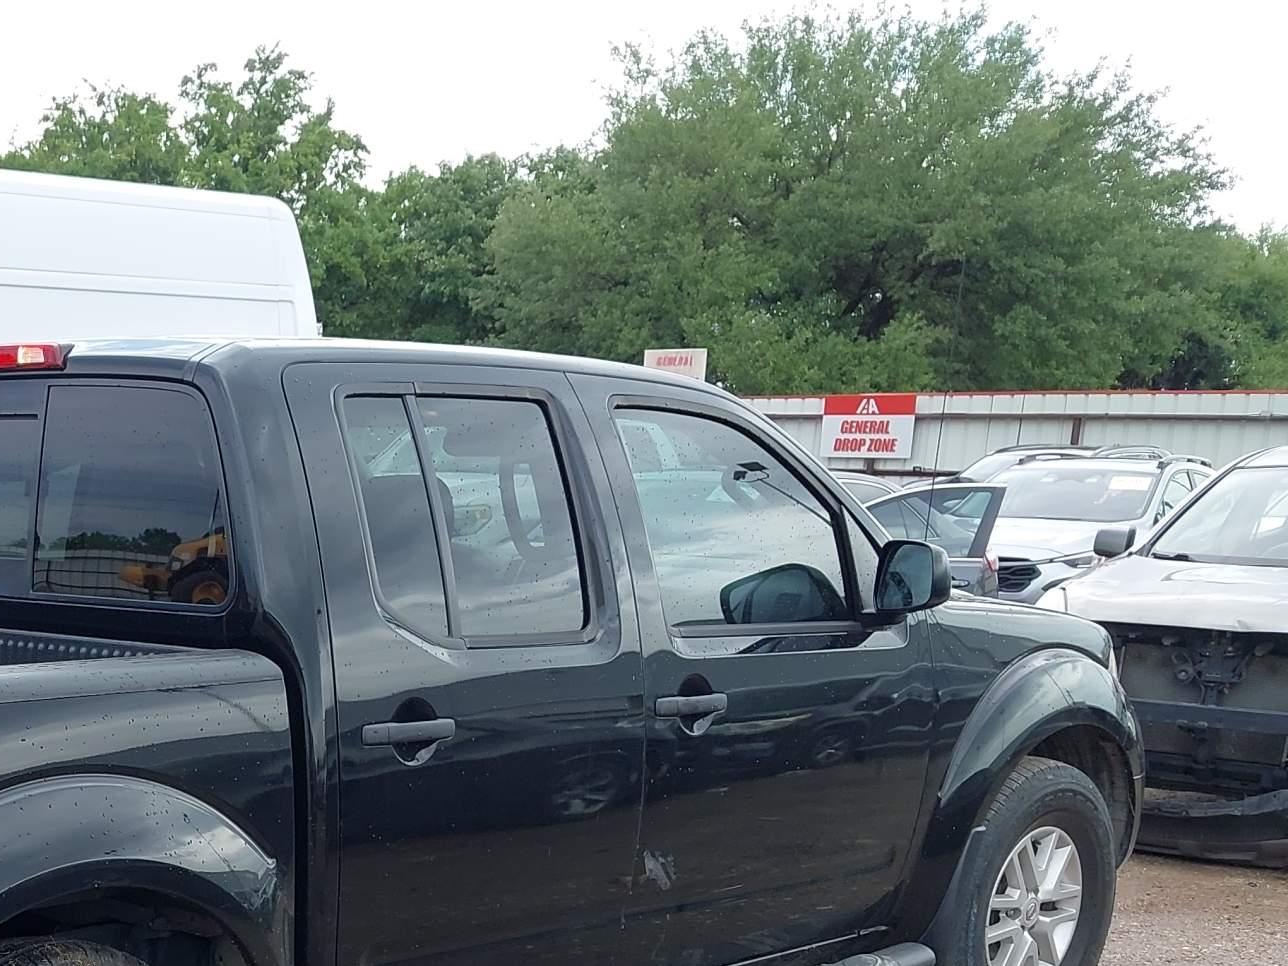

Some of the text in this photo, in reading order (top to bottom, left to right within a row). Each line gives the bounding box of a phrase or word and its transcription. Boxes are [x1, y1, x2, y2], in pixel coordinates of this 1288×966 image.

[840, 420, 890, 434] GENERAL
[833, 438, 897, 452] DROP ZONE
